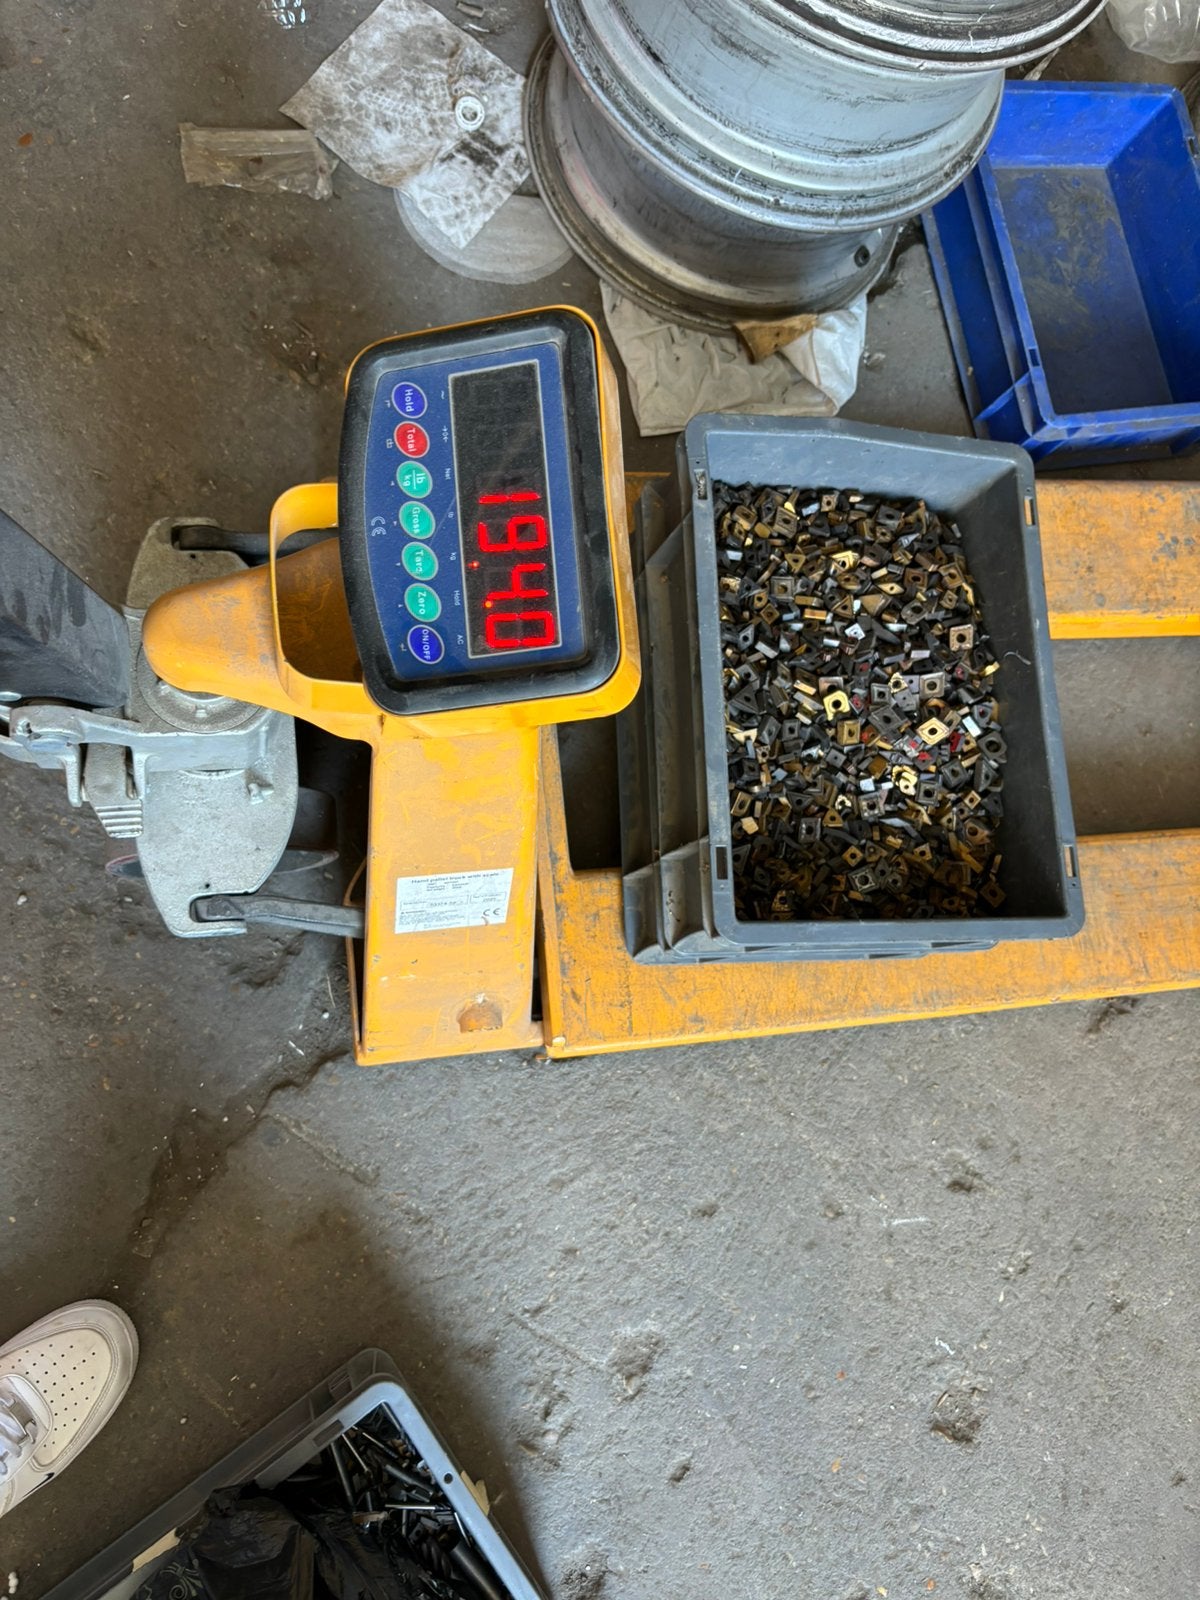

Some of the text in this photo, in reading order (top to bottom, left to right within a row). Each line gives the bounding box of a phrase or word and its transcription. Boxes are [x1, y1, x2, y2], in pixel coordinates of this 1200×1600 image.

[405, 387, 414, 412] Hold
[406, 427, 417, 452] Total
[403, 474, 412, 487] kg
[416, 472, 425, 484] lb
[411, 506, 421, 534] Gross
[478, 491, 555, 648] 194.0
[417, 591, 427, 615] Zero
[422, 628, 431, 660] ON/OFF
[457, 634, 465, 645] AC
